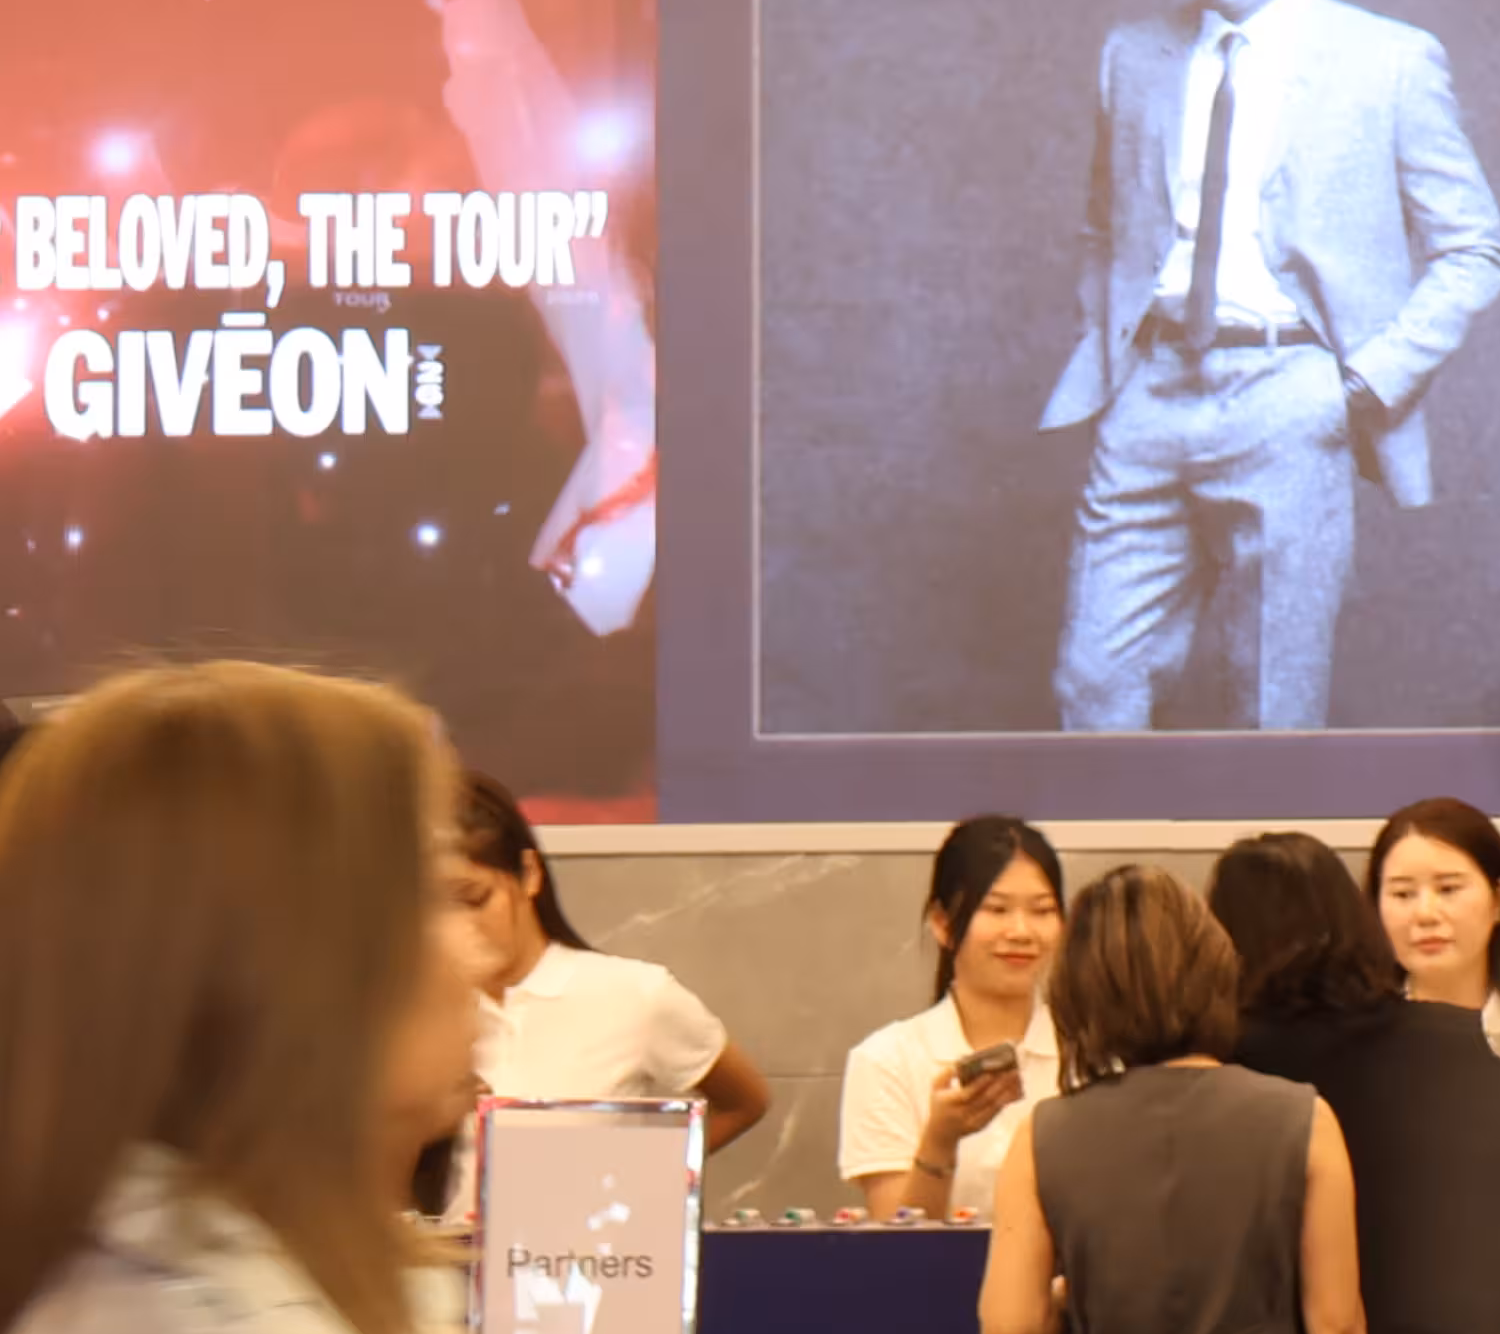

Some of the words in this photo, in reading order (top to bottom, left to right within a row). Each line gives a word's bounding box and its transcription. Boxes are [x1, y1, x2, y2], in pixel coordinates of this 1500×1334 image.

[16, 193, 285, 308] BELOVED,
[299, 191, 412, 287] THE
[422, 190, 608, 288] TOUR”
[44, 312, 410, 440] GIVĒON
[507, 1247, 654, 1278] Partners
